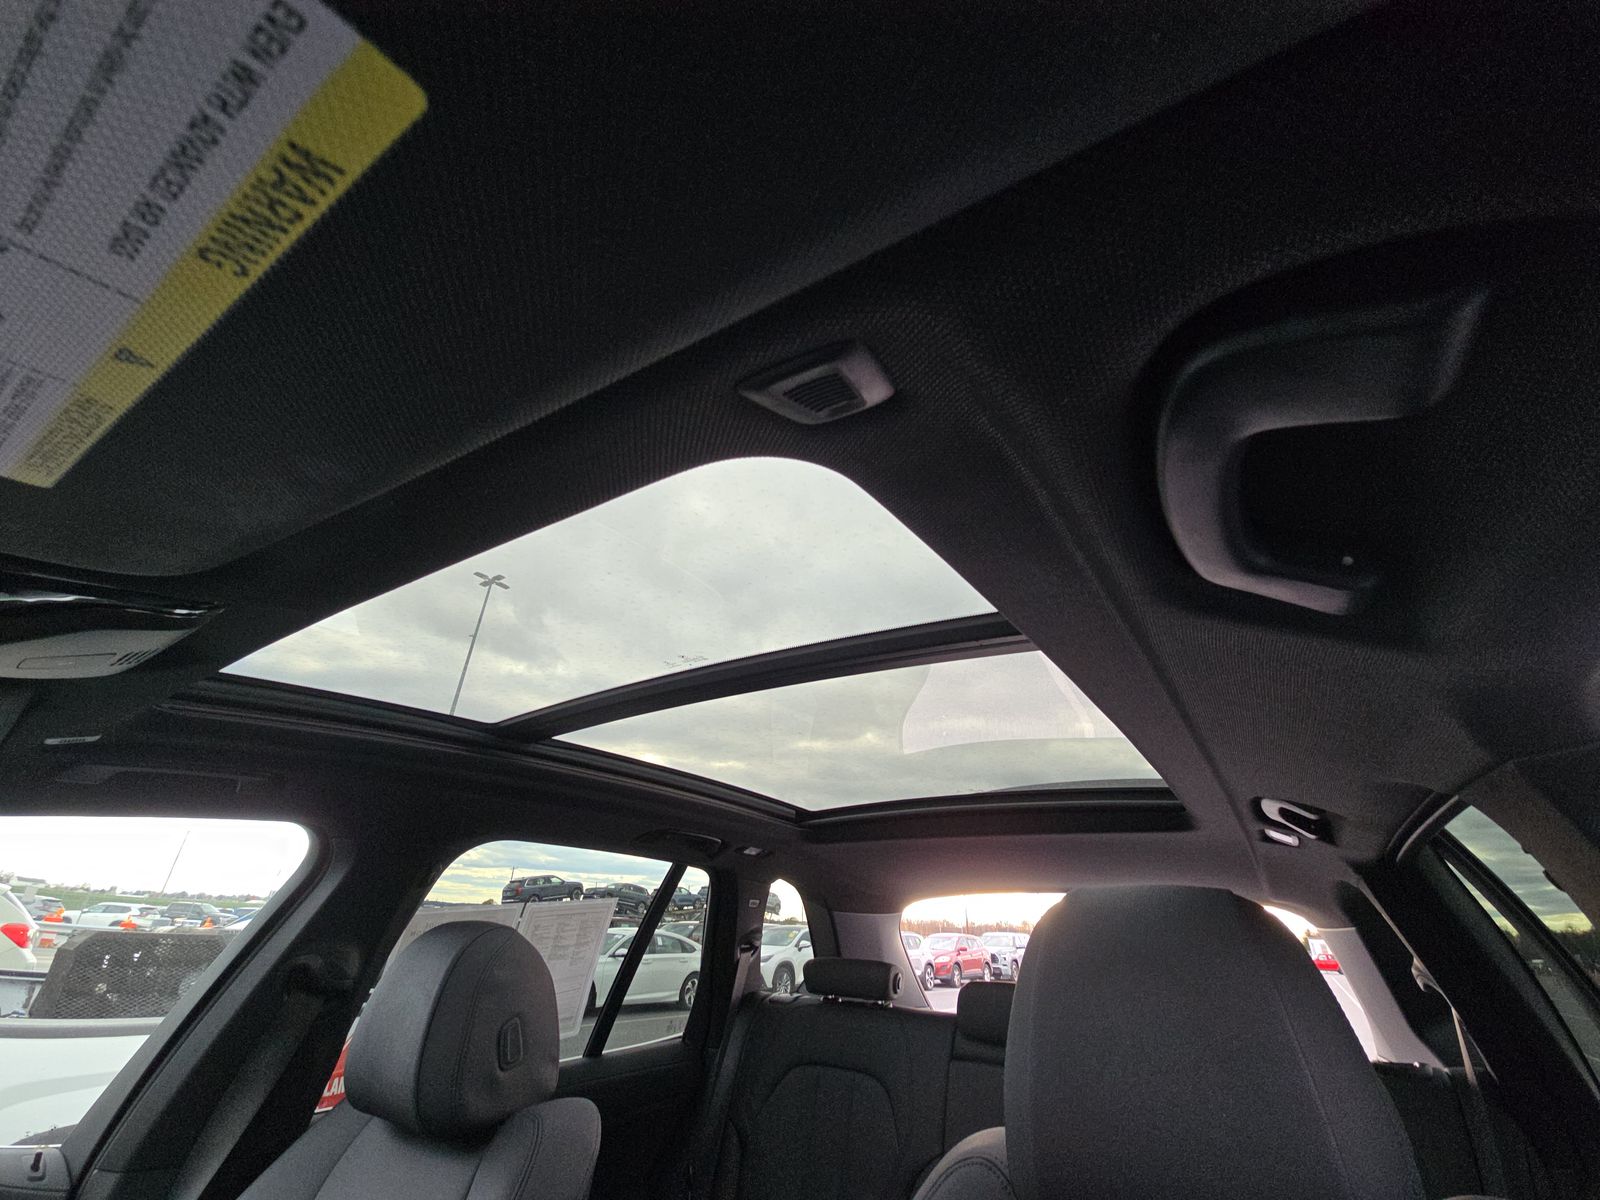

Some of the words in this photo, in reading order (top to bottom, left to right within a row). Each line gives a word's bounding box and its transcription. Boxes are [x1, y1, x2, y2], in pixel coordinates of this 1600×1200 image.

[208, 57, 263, 119] WITH
[150, 106, 226, 200] ADVANCED
[129, 194, 167, 228] AIR
[198, 141, 346, 277] WARNING
